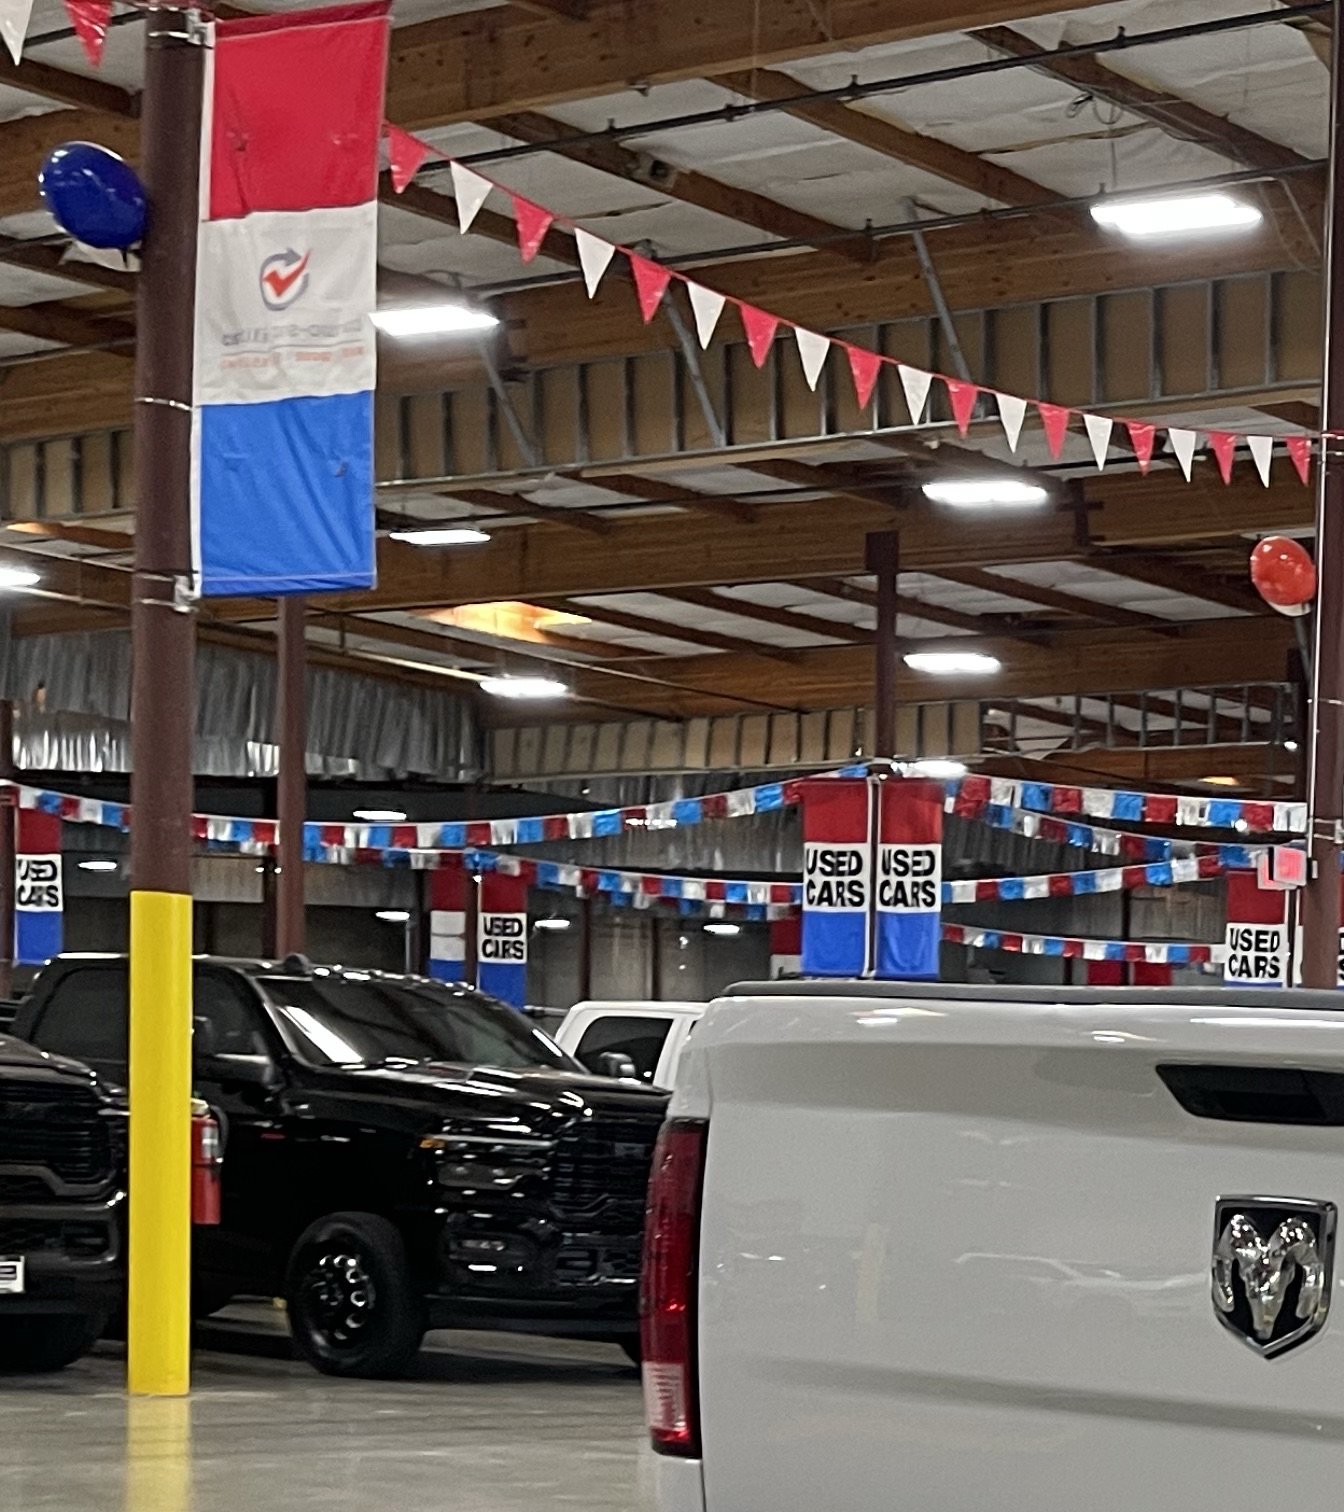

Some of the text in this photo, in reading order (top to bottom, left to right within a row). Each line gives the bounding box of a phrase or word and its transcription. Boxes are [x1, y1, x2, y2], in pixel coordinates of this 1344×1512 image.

[18, 859, 58, 882] UED
[806, 849, 863, 877] USED
[882, 849, 936, 877] USED
[806, 880, 865, 907] CARS
[879, 880, 936, 907] CARS
[1230, 928, 1280, 953] USED
[1228, 954, 1280, 978] CARS
